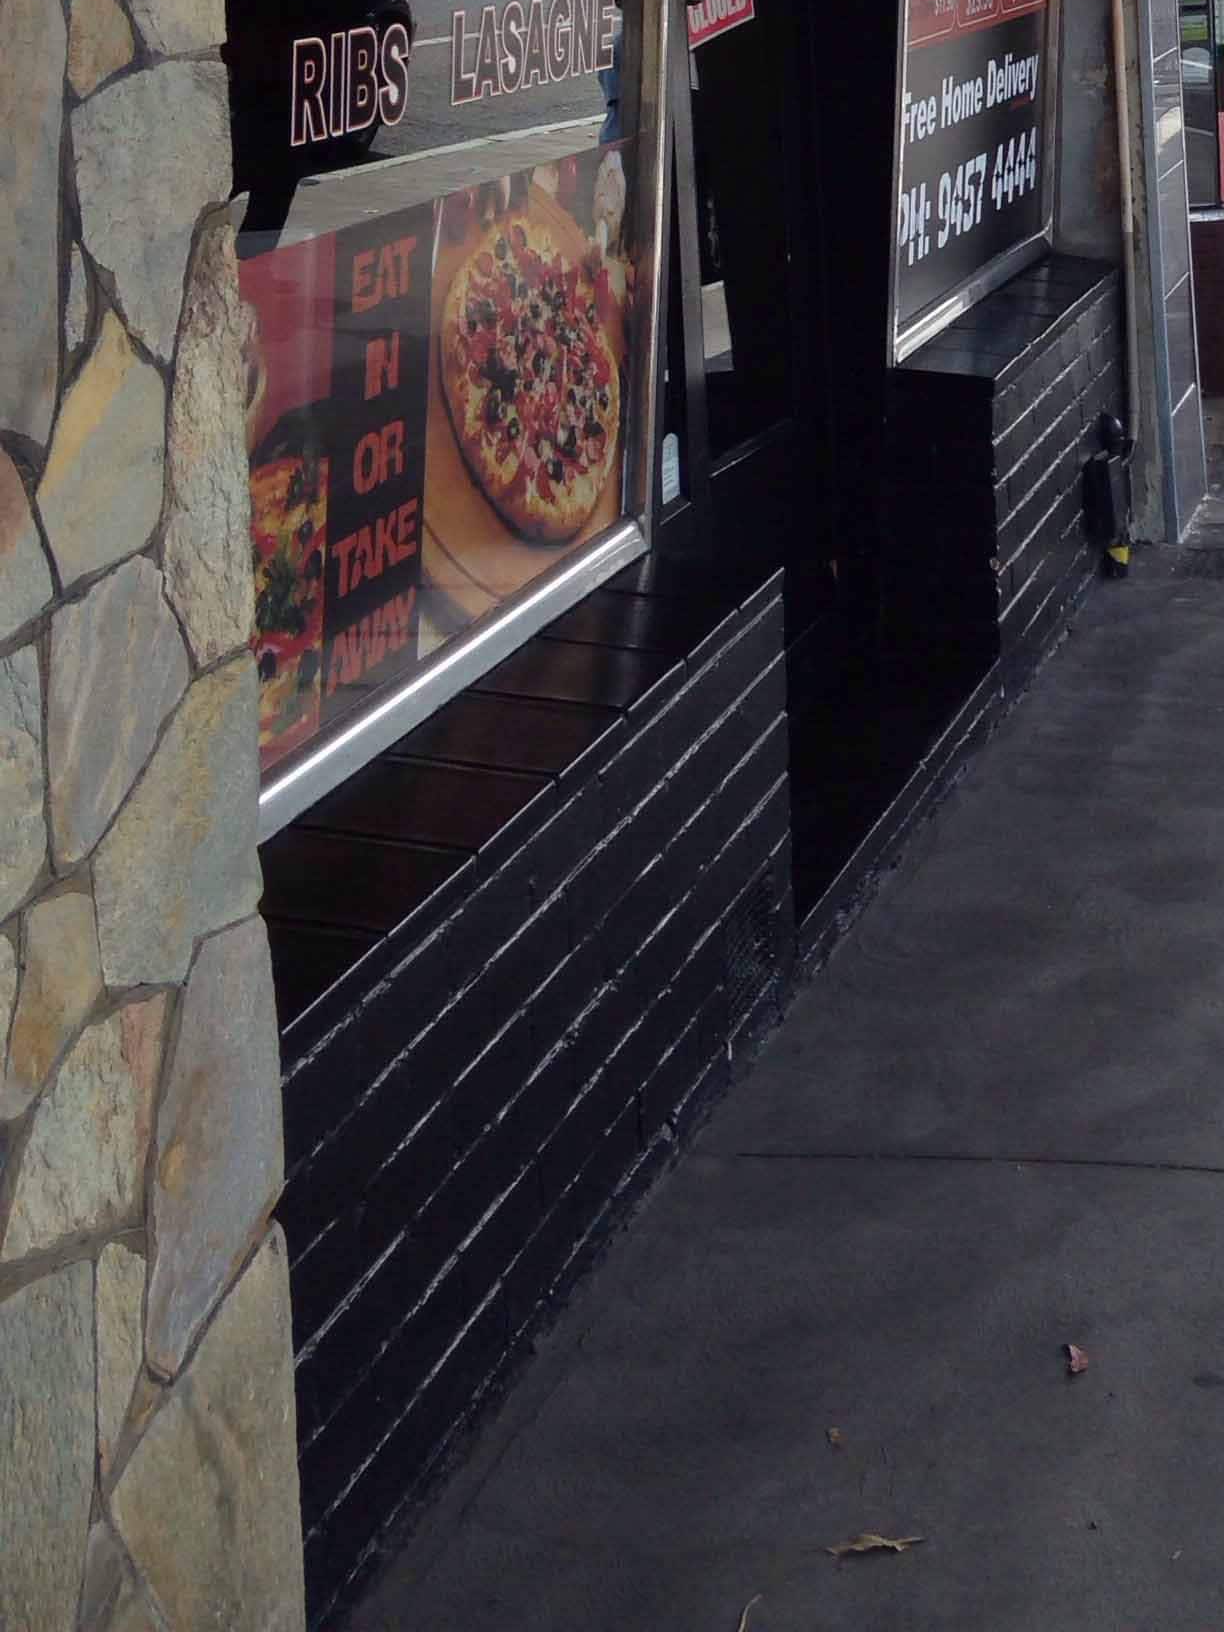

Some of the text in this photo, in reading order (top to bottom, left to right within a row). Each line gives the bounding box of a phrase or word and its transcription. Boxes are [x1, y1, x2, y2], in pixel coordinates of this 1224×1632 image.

[290, 23, 410, 147] RIBS
[903, 53, 1039, 144] Free Home Delivery
[938, 152, 987, 249] 9457
[991, 126, 1037, 211] 4444
[352, 234, 417, 313] EAT
[353, 420, 405, 495] OR
[331, 497, 418, 598] TAKE
[326, 585, 416, 698] AWAY
